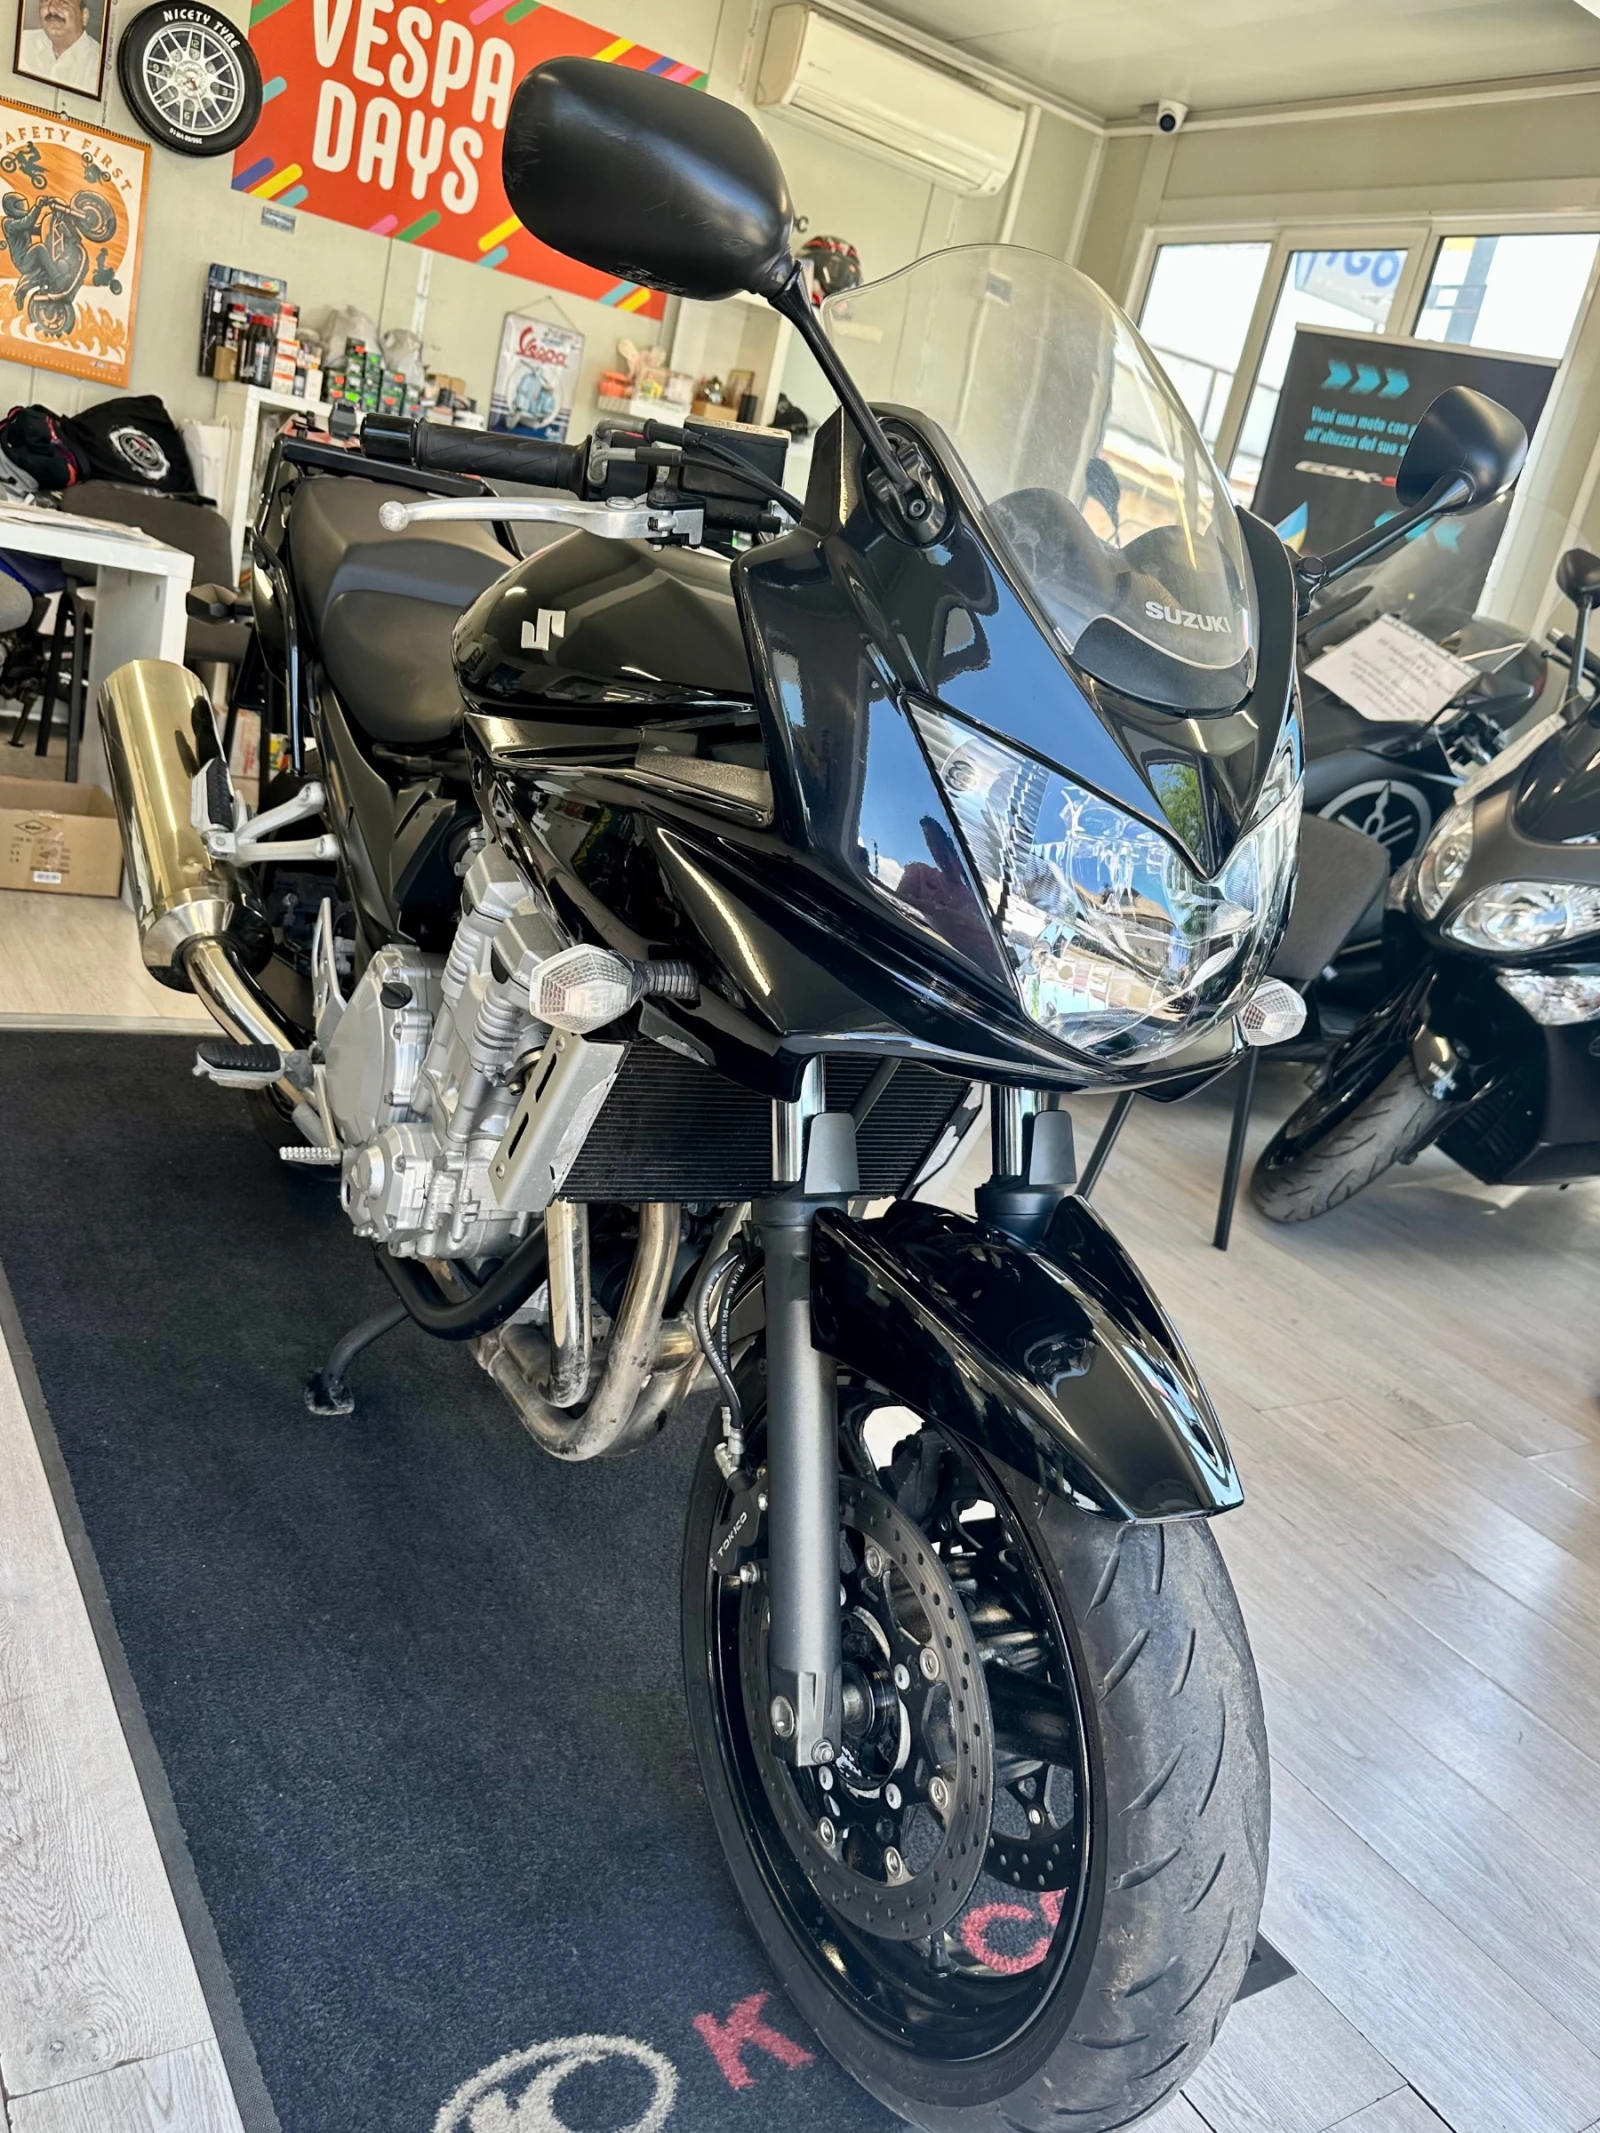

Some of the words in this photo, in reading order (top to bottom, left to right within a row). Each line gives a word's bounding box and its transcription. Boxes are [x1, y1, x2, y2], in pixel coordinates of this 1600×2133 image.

[163, 9, 211, 25] NICETY
[213, 21, 241, 48] TYRE
[313, 0, 515, 130] VESPA
[0, 126, 70, 151] AFETY
[81, 138, 132, 192] FIRST
[312, 79, 483, 214] DAYS
[516, 326, 568, 368] Vespa
[1311, 405, 1337, 423] Vuoi
[1335, 413, 1357, 427] una
[1357, 416, 1386, 432] moto
[1387, 421, 1409, 435] con
[1358, 435, 1378, 451] del
[1377, 440, 1399, 455] suo
[1145, 601, 1232, 633] SUZUKI
[717, 1512, 748, 1557] TOKICO
